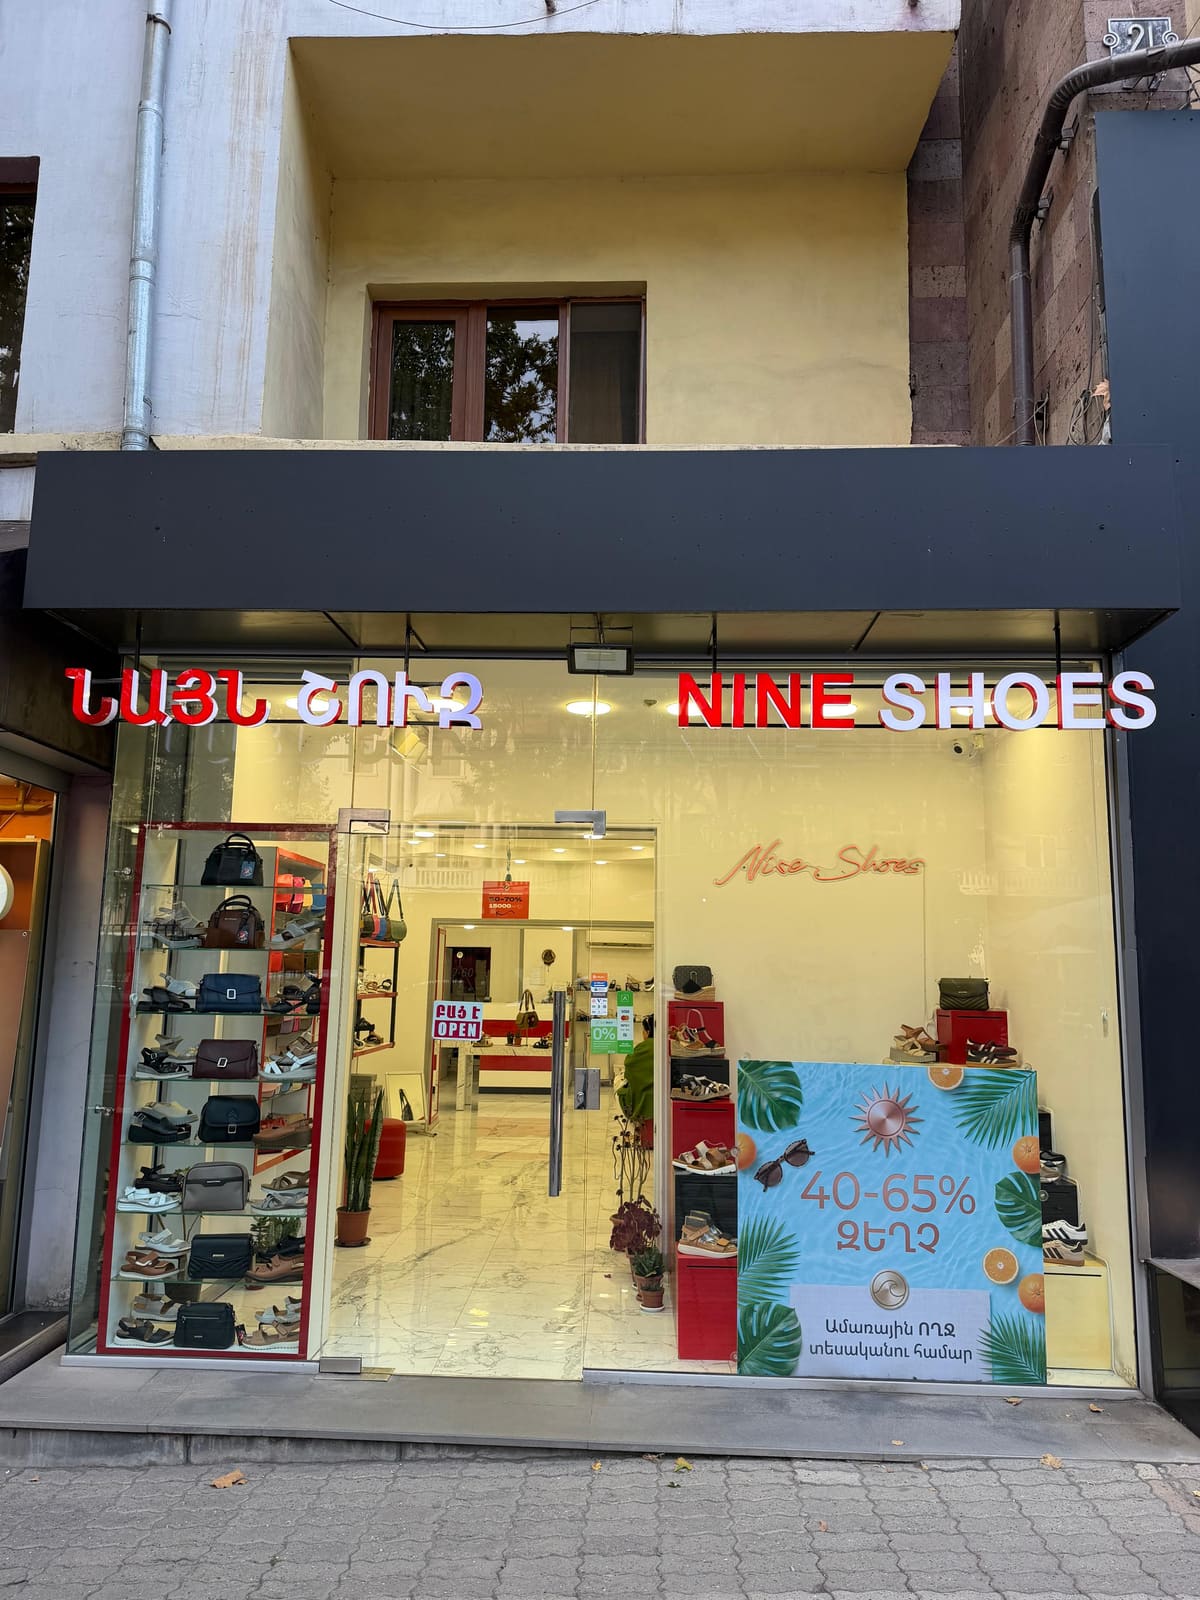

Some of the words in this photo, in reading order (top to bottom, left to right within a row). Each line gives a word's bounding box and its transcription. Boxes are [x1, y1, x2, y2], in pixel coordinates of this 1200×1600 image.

[1127, 23, 1154, 52] 21
[65, 667, 271, 728] ՆԱՅՆ
[298, 668, 483, 730] ՇՈՒԶ
[678, 672, 855, 729] NINE
[878, 671, 1157, 731] SHOES
[813, 843, 926, 882] Shoes
[437, 1021, 477, 1038] OPEN
[592, 1027, 616, 1041] 0%
[800, 1170, 977, 1215] 40-65%
[836, 1219, 940, 1254] ԶԵՂՉ
[825, 1318, 913, 1339] Ամառային
[918, 1321, 956, 1338] ՈՂՋ
[809, 1340, 909, 1360] տեսականու
[913, 1343, 973, 1364] համար
